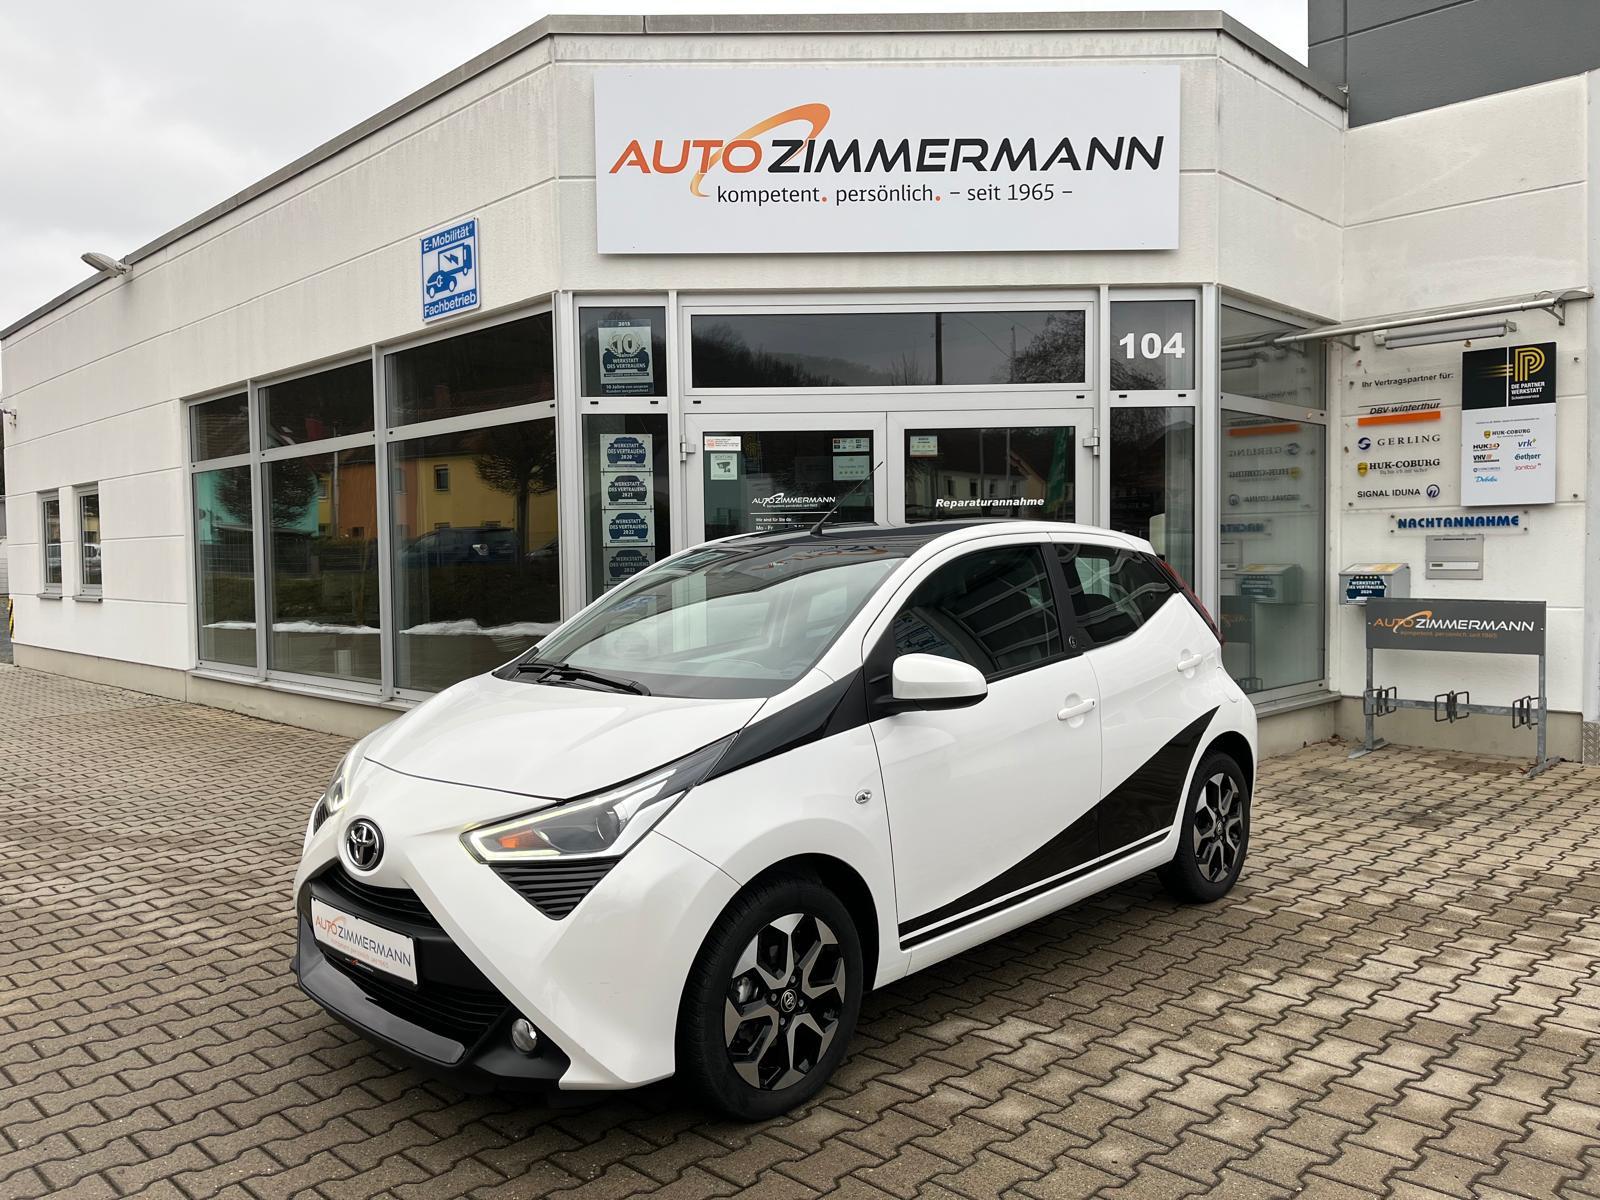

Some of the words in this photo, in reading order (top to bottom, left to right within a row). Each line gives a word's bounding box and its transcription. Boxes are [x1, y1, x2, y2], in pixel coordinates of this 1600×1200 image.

[610, 139, 762, 174] AUTO
[768, 136, 1164, 174] ZIMMERMANN
[717, 185, 828, 204] kompetent.
[835, 184, 941, 205] persönlich.
[966, 184, 1001, 202] seit
[1007, 184, 1055, 202] 1965
[423, 225, 470, 252] E-Mobilität
[424, 293, 476, 317] Fachbetrieb
[611, 333, 636, 354] 10
[1119, 332, 1185, 359] 104
[1374, 374, 1437, 386] Vertragspartner
[1439, 371, 1454, 380] für:
[1521, 381, 1545, 389] PARTNER
[1511, 387, 1543, 395] WERKSTATT
[1377, 434, 1440, 446] GERLING
[1369, 459, 1441, 470] HUK-COBURG
[775, 496, 836, 504] ZIMMERMANN
[1357, 489, 1389, 498] SIGNAL
[1392, 488, 1421, 497] IDUNA
[935, 497, 1045, 509] Reparaturannahme
[1397, 515, 1519, 529] NACHTANNAHME
[1374, 618, 1414, 628] AUTO
[1415, 618, 1535, 632] ZIMMERMANN
[315, 915, 338, 936] AUTO
[338, 925, 412, 968] ZIMMERMANN
